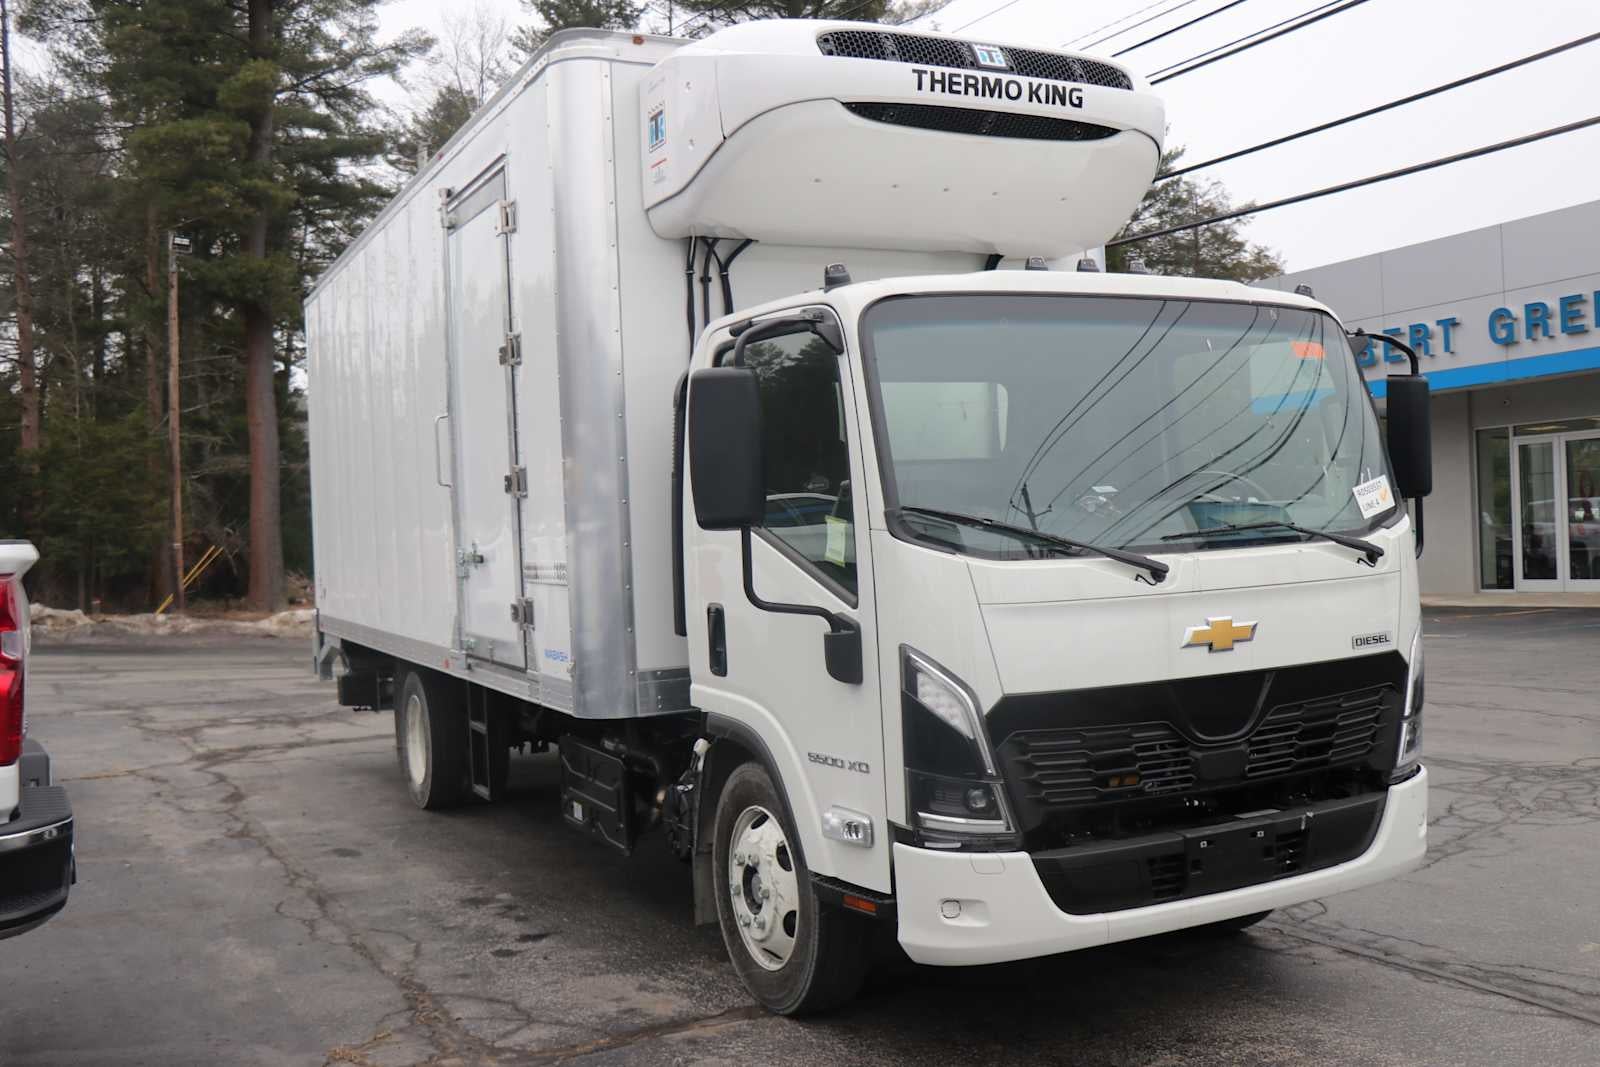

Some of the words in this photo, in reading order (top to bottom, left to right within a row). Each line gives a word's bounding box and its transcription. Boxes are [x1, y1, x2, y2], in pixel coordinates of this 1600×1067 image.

[912, 68, 1022, 101] THERMO
[1028, 81, 1083, 109] KING
[1489, 290, 1600, 345] GRE
[1355, 632, 1391, 646] DIESEL
